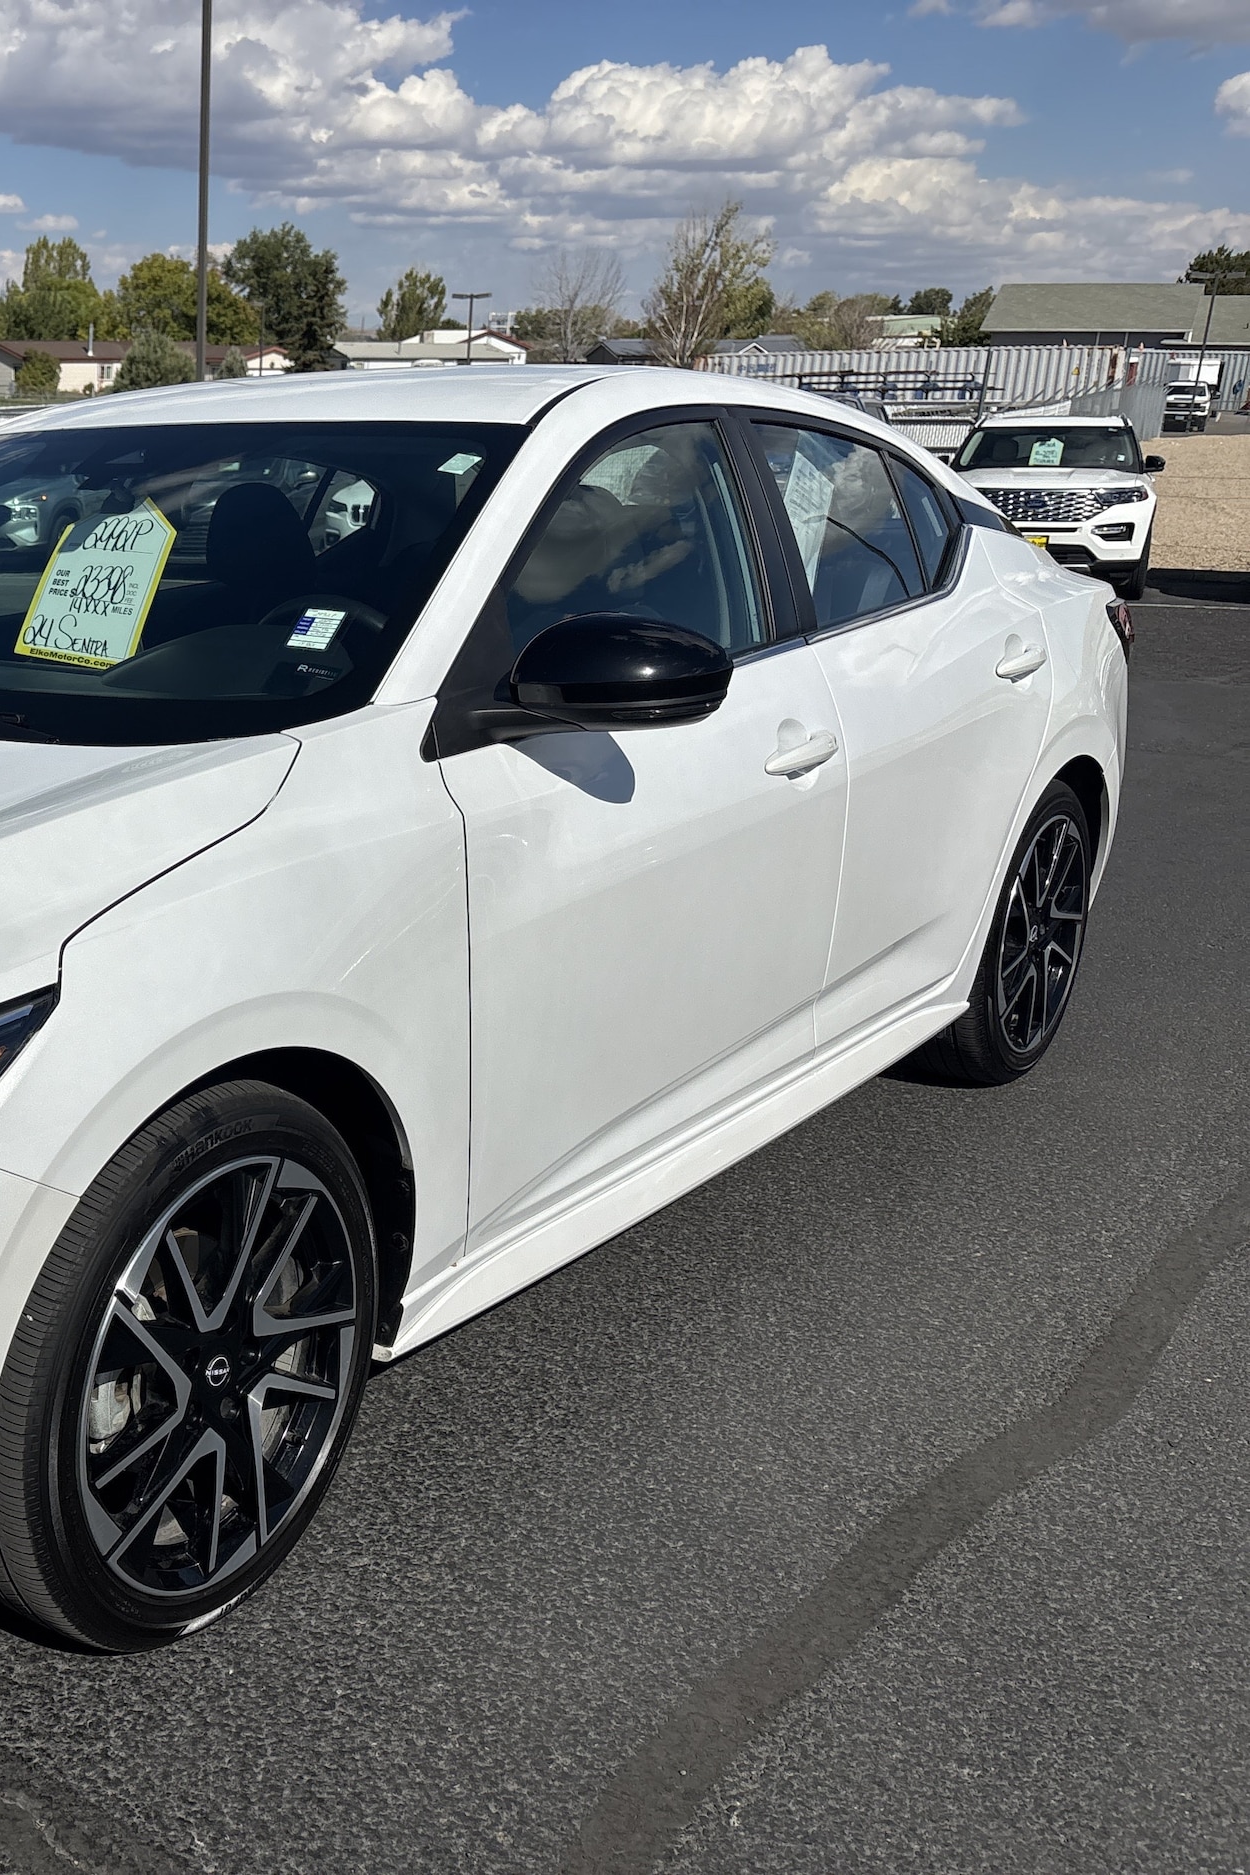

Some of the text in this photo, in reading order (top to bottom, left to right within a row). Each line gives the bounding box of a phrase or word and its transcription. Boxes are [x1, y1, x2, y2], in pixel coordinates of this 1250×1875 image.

[56, 569, 70, 577] OUR
[52, 578, 70, 588] BEST
[48, 588, 69, 597] PRICE
[110, 605, 134, 616] MILES
[23, 614, 54, 647] 24
